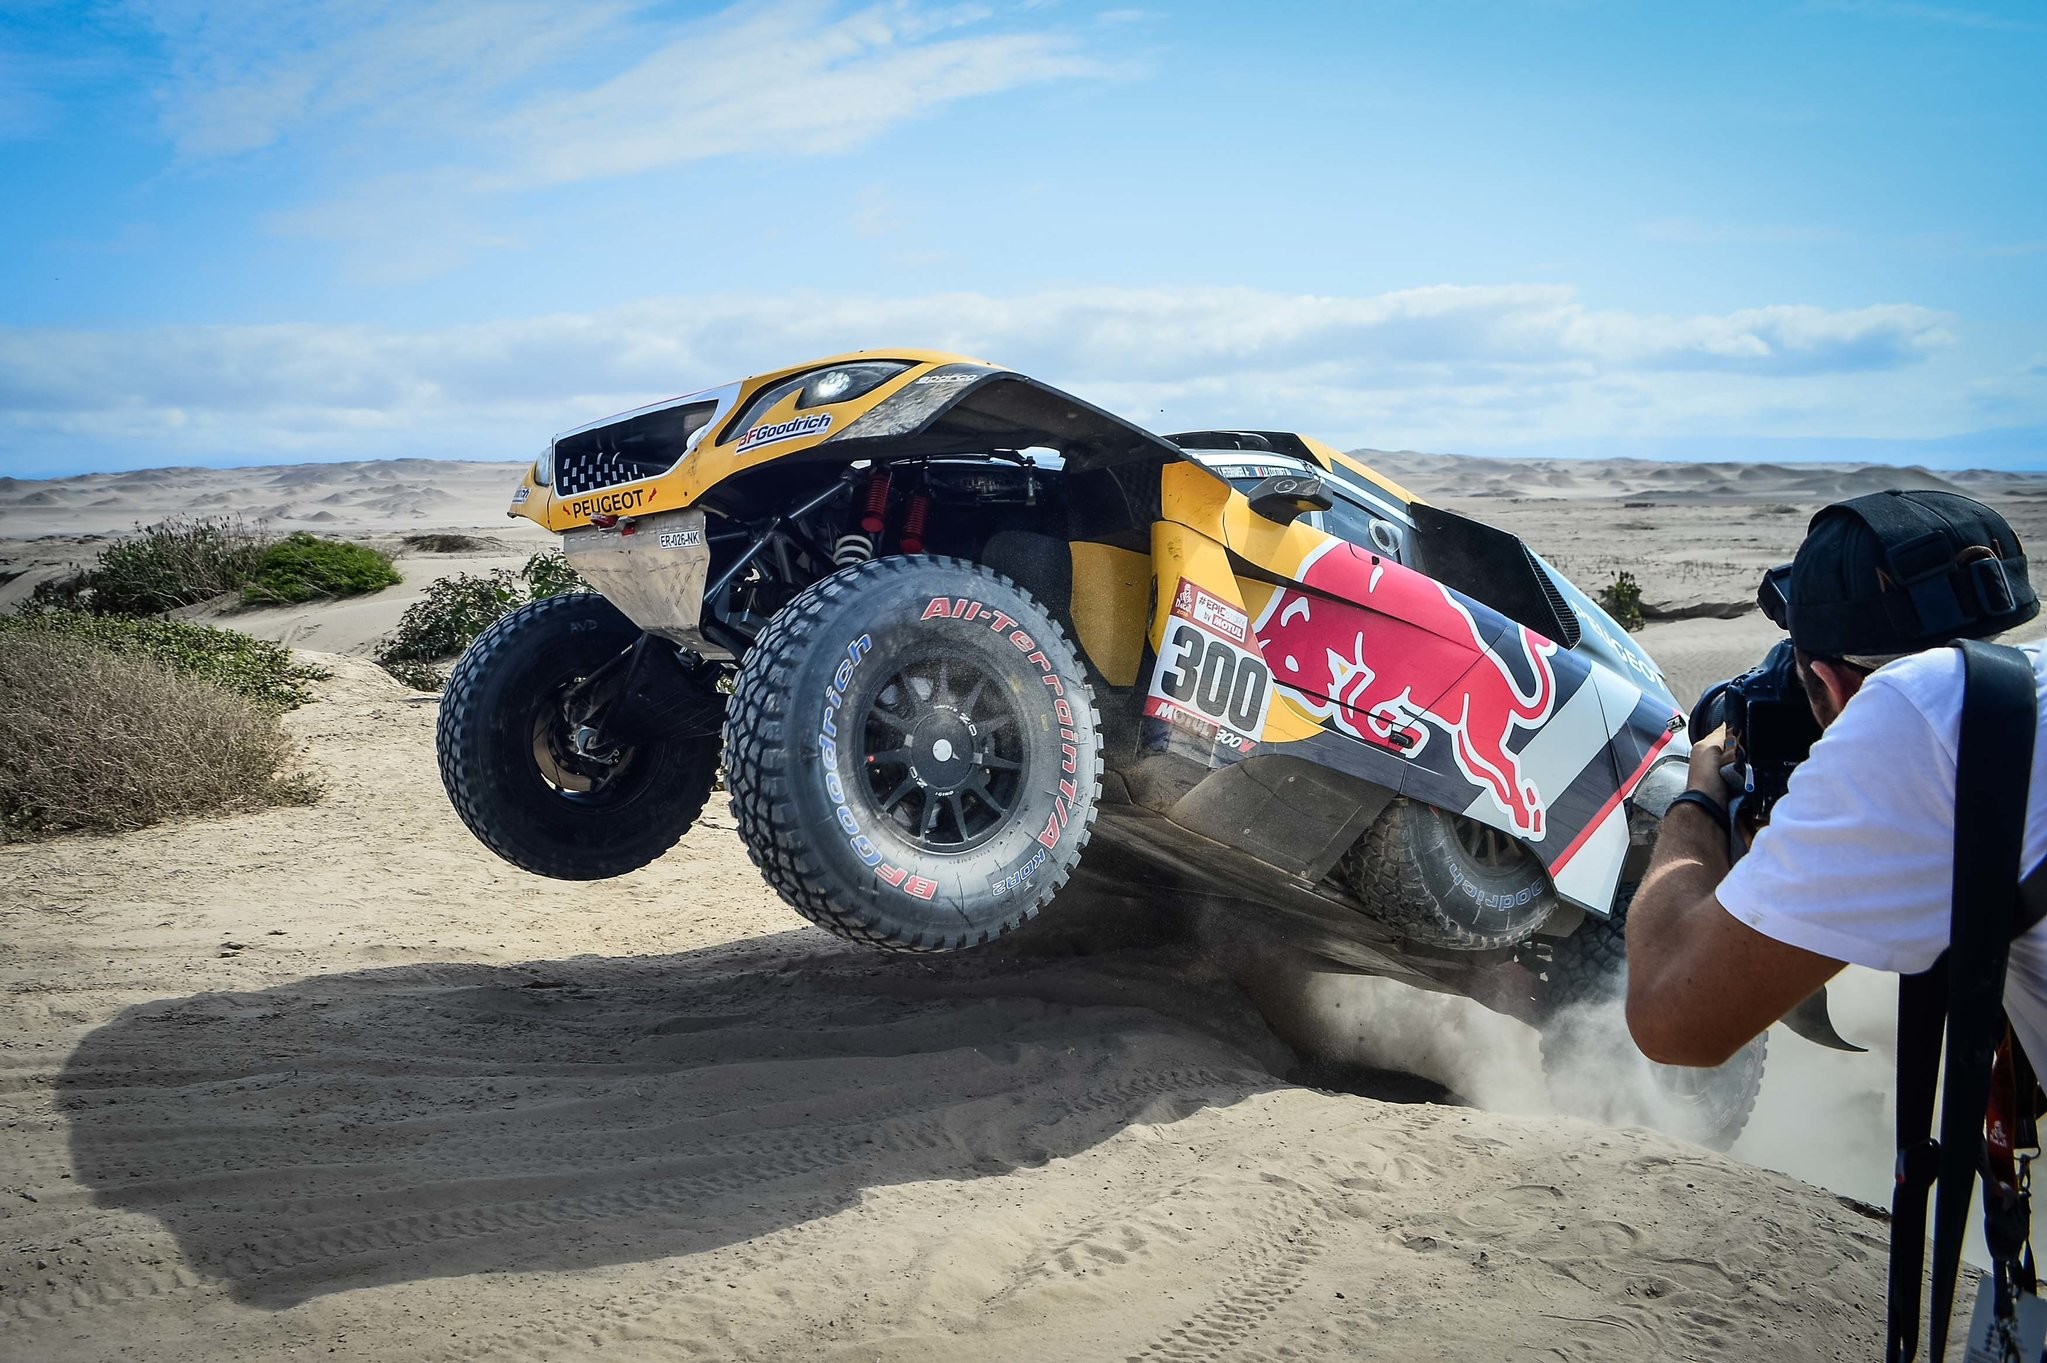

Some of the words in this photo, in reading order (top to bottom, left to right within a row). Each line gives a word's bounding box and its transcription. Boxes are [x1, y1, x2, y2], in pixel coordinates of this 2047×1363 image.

[738, 414, 831, 447] BFGoodrich
[572, 489, 644, 519] PEUGEOT
[1213, 616, 1243, 637] MOTUL
[1569, 598, 1665, 691] PEUGEOT
[1160, 625, 1268, 732] 300
[1155, 702, 1210, 736] MOTUL
[1215, 729, 1256, 752] 300V
[818, 632, 938, 901] BFGoodrich
[992, 848, 1046, 896] KDR2
